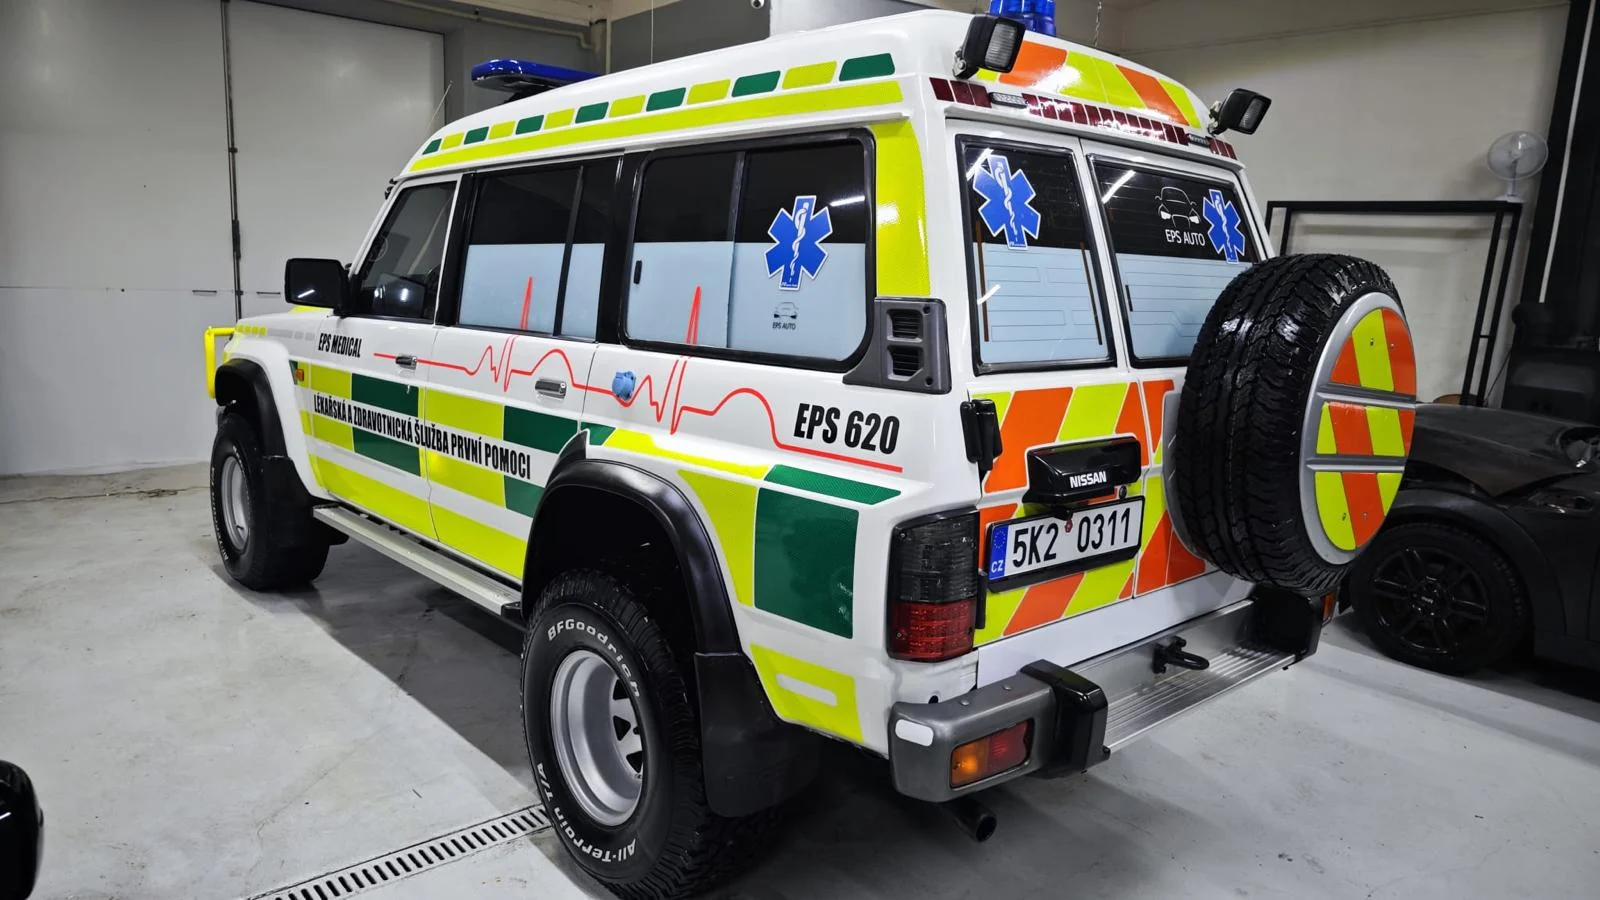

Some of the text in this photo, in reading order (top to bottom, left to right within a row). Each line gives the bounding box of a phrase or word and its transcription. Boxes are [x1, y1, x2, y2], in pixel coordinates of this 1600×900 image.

[1165, 229, 1205, 247] EPS AUTO
[782, 322, 797, 331] AUTO
[318, 332, 362, 358] EPS MEDICAL
[313, 392, 530, 480] LÉKAŘSKÁ A ZDRAVOTNICKÁ ŠLUŽBA PRVNÍ POMOCI
[794, 403, 900, 455] EPS 620
[1069, 471, 1107, 488] NISSAN
[1013, 508, 1131, 568] 5K2 0311
[991, 560, 1003, 573] CZ
[547, 619, 640, 697] BFGoodrich
[537, 763, 554, 802] T/A
